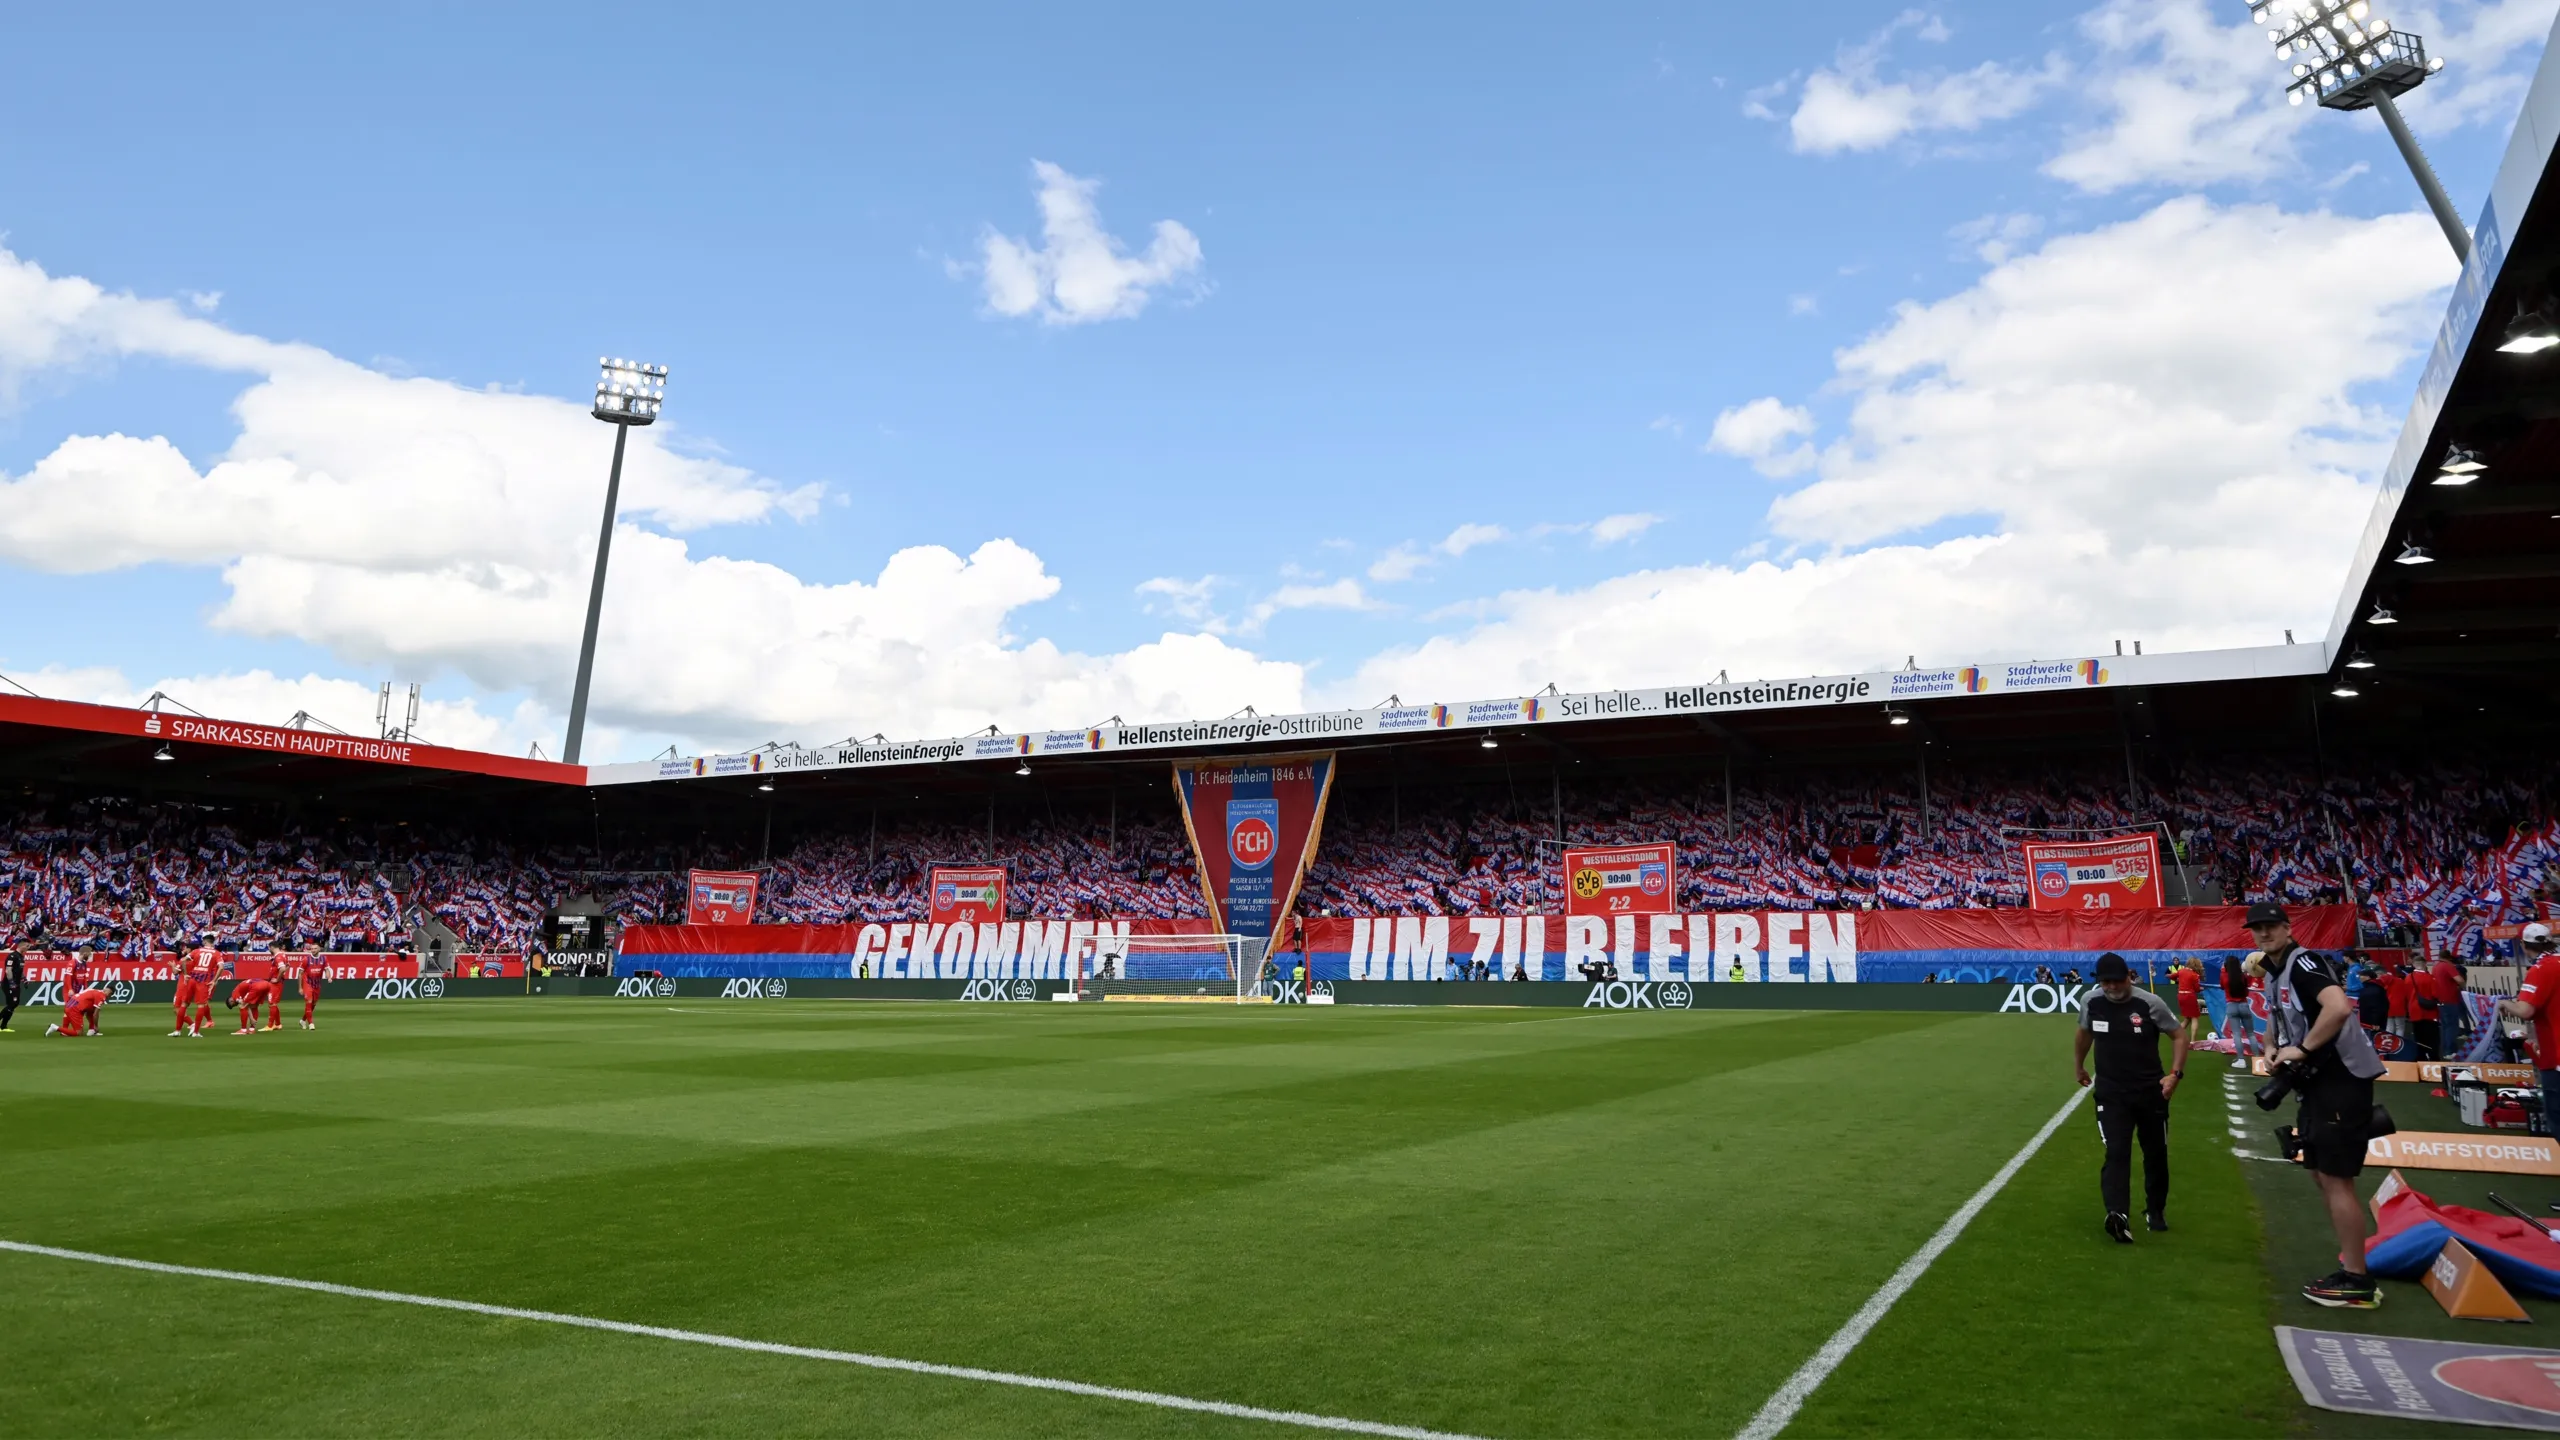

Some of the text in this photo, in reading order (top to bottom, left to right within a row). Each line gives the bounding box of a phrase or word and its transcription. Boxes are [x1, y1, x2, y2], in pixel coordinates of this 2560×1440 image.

[1892, 670, 1955, 684] Stadtwerke
[2008, 662, 2073, 678] Stadtwerke
[2006, 672, 2072, 687] Heidenheim
[1890, 680, 1954, 695] Heidenheim
[1561, 678, 1870, 716] Sei helle... HellensteinEnergie
[1381, 708, 1428, 720] Stadtwerke
[1468, 701, 1519, 714] Stadtwerke
[1378, 717, 1427, 729] Heidenheim
[1466, 711, 1518, 723] Heidenheim
[1045, 731, 1086, 743] Stadtwerke
[1118, 713, 1363, 746] HellensteinEnergie-Osttribüne
[171, 719, 285, 748] SPARKASSEN
[290, 735, 411, 763] HAUPTTRIBÜNE
[976, 737, 1015, 748] Stadtwerke
[1043, 740, 1085, 752] Heidenheim
[773, 741, 964, 769] Sei helle... HellensteinEnergie
[975, 746, 1014, 756] Heidenheim
[1189, 766, 1315, 785] 1. FC Heidenheim 1846 e.V.
[1236, 831, 1268, 852] FCH
[1582, 852, 1659, 865] WESTFALENSTADION
[2033, 842, 2148, 860] ALBSTADION HEIDENHEIM
[1576, 871, 1600, 889] BVB
[1608, 874, 1631, 883] 90:00
[1645, 877, 1661, 887] FCH
[2077, 869, 2106, 880] 90:00
[2043, 878, 2063, 889] FCH
[714, 892, 729, 900] 90:00
[940, 896, 952, 904] FCH
[961, 890, 977, 898] 90:00
[2082, 892, 2111, 909] 2:0
[1609, 895, 1631, 911] 2:2
[711, 910, 726, 923] 3:2
[959, 908, 975, 921] 4:2
[850, 921, 1130, 980] GEKOMMEN
[1349, 914, 1857, 983] UM ZU BLEIBEN
[198, 952, 212, 967] 10
[365, 967, 398, 979] FCH
[365, 979, 417, 1000] AOK
[614, 977, 654, 997] AOK
[721, 978, 765, 998] AOK
[960, 979, 1008, 1001] AOK
[1583, 982, 1655, 1008] AOK
[1999, 984, 2083, 1013] AOK
[2401, 1140, 2552, 1162] RAFFSTOREN
